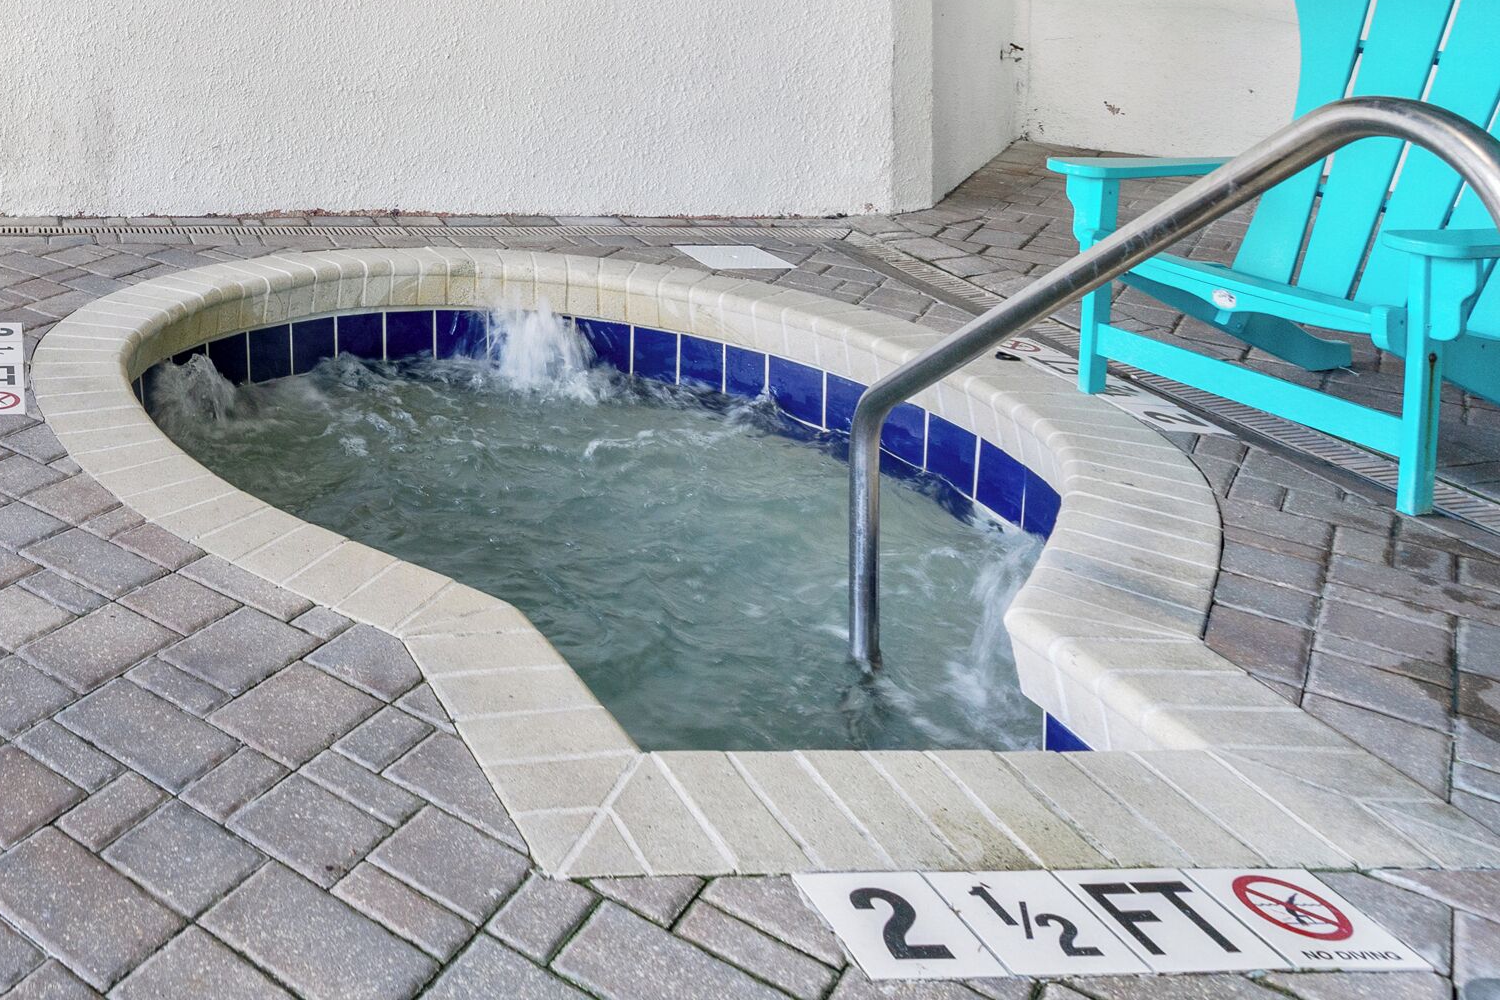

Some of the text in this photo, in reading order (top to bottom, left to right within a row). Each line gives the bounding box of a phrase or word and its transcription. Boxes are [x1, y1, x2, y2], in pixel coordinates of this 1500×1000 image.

[849, 888, 956, 959] 2
[1079, 880, 1242, 956] FT
[1301, 951, 1403, 960] NO DIVING
